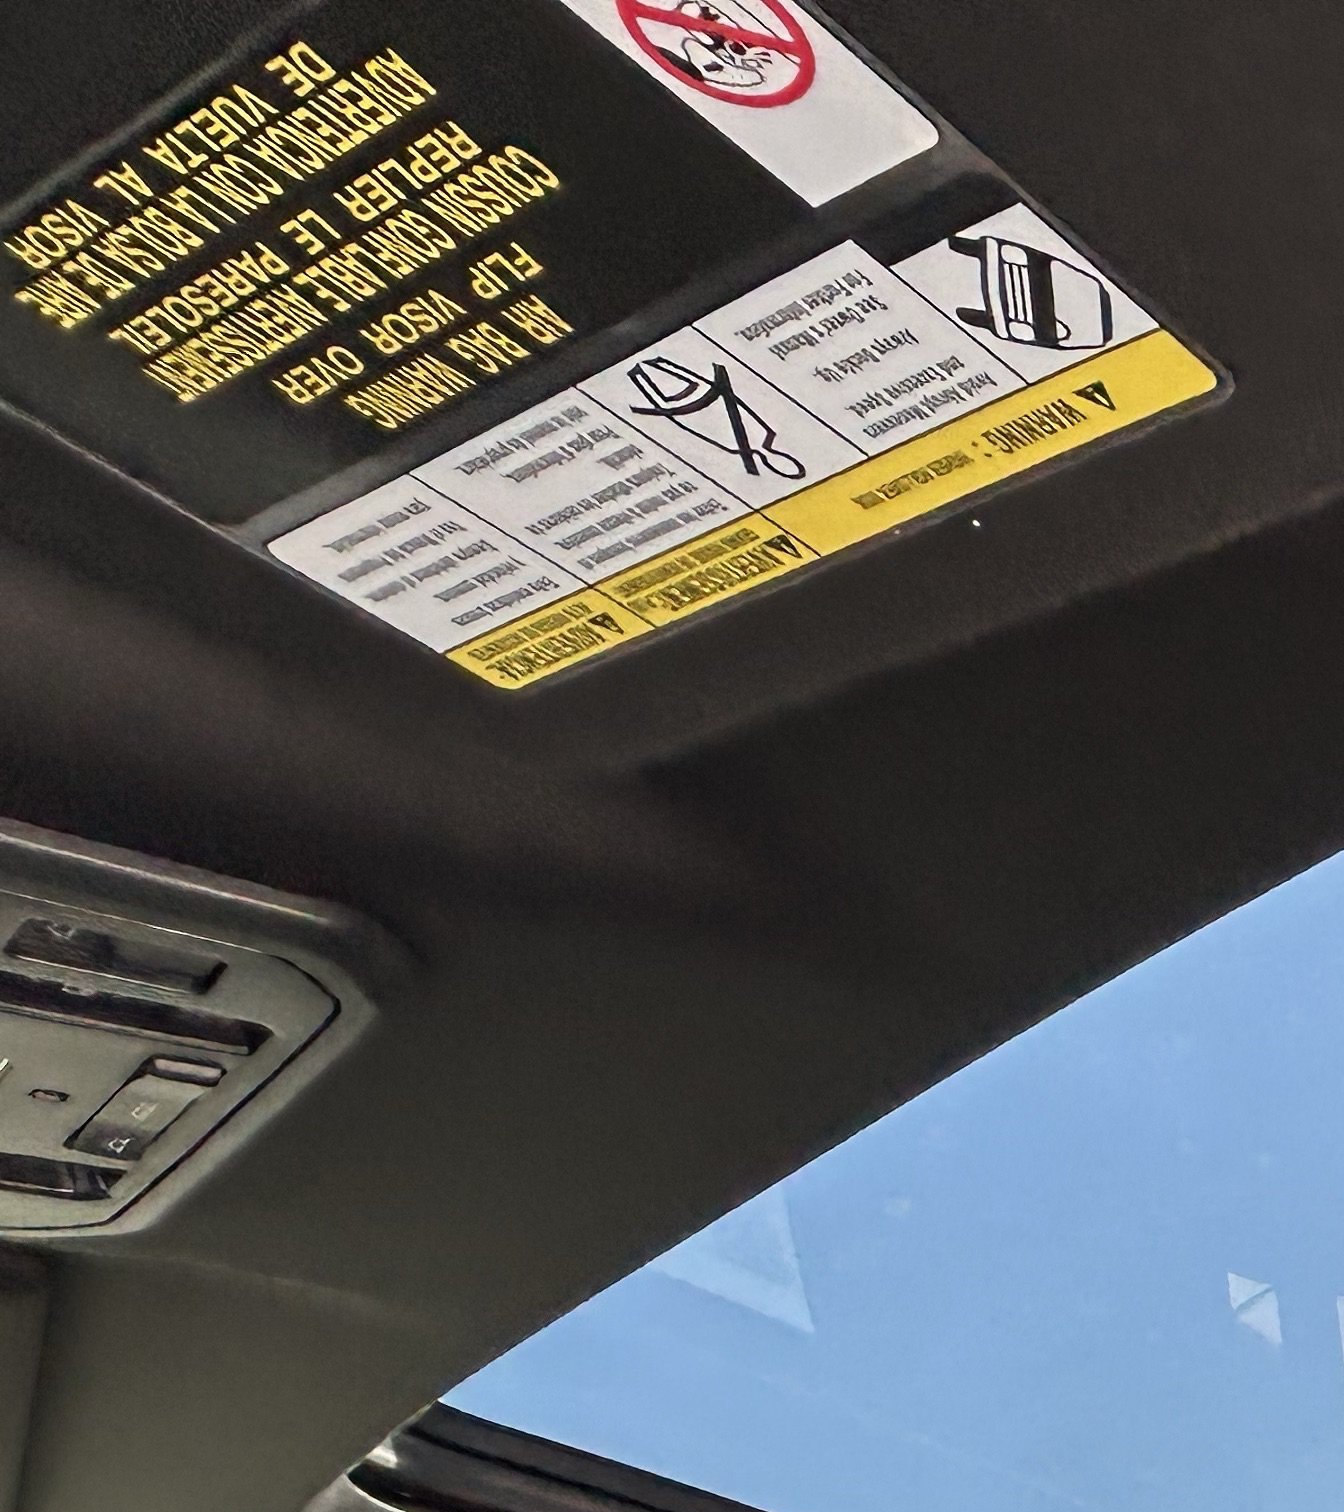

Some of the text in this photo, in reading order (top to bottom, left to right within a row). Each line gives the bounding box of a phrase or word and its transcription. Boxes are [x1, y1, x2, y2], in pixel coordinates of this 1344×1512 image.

[4, 41, 335, 271] DE VUELTA AL VISOR
[15, 47, 437, 330] ADVERTENCIA CON LA BOLSA DE AIRE
[107, 121, 481, 355] REPLIER LE PARESOLEIL
[143, 146, 560, 403] COUSSIN GONFLABLE AVERTISSEMENT
[272, 242, 544, 405] FLIP VISOR OVER
[344, 294, 573, 430] AIR BAG WARNING
